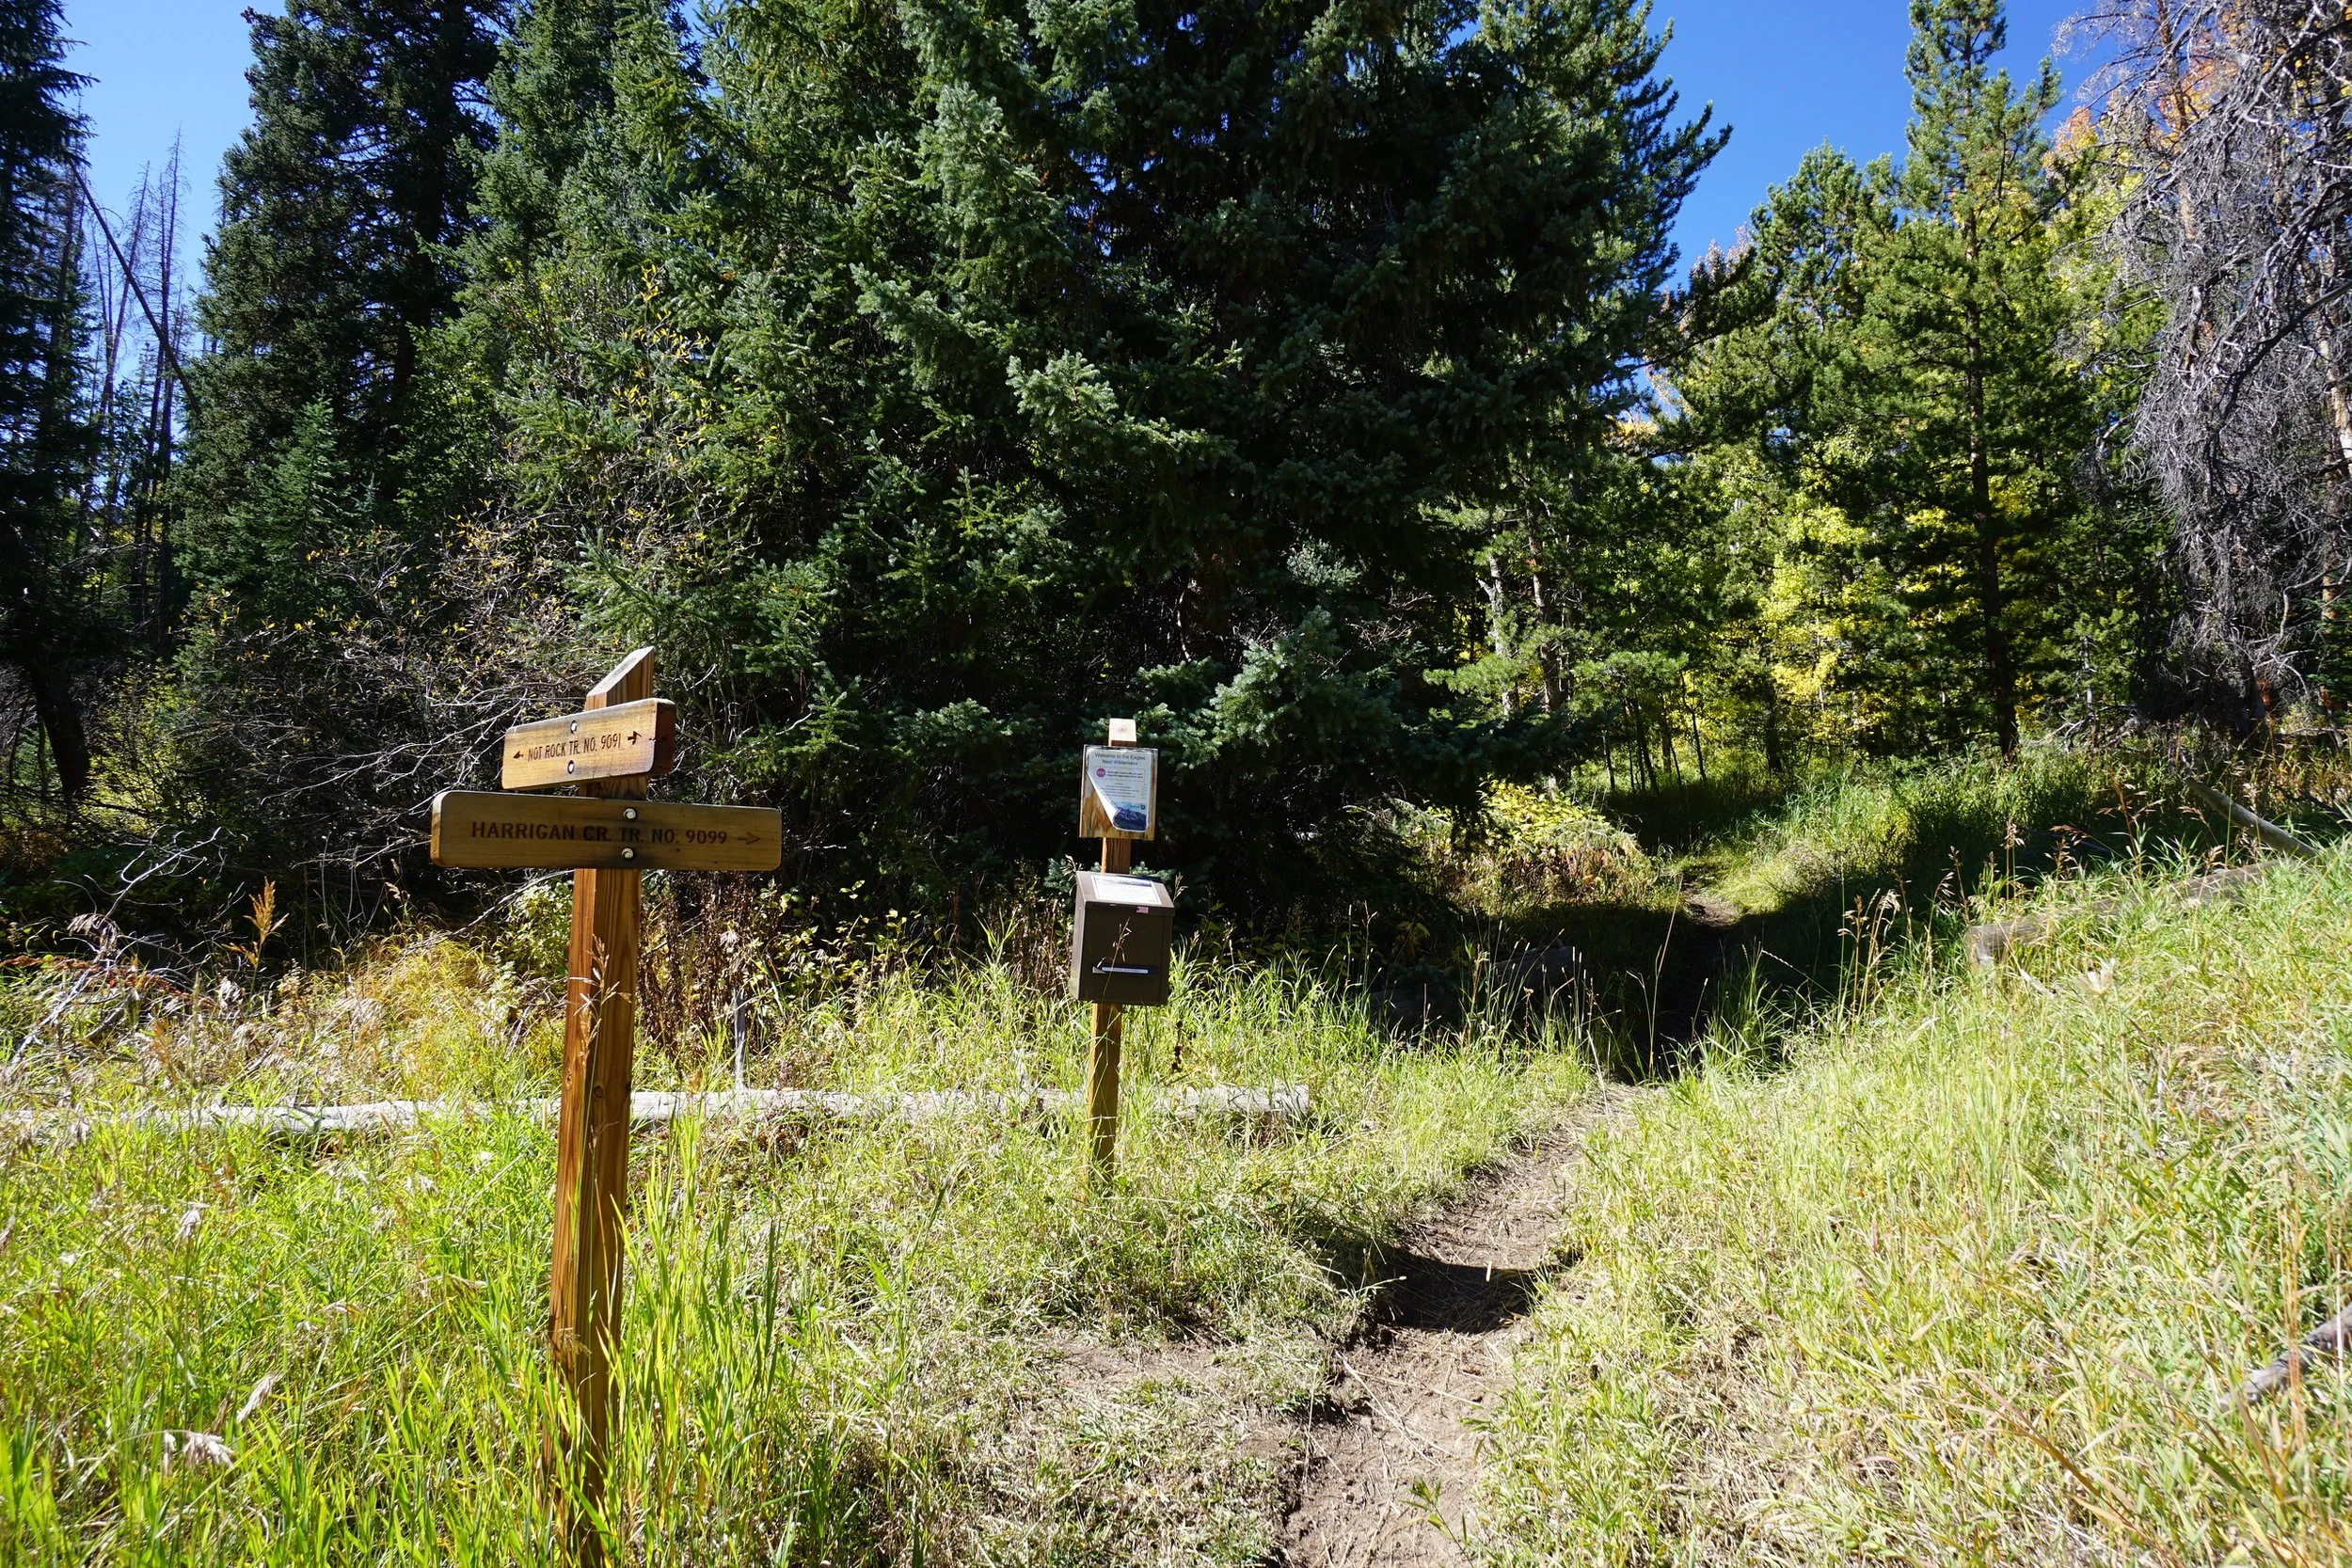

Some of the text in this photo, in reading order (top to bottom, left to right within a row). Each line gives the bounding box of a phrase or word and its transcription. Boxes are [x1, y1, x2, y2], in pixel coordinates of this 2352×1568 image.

[528, 733, 622, 762] NOT ROCK TR. NO. 9091
[471, 821, 727, 845] HARRIGAN CR. TR. NO. 9099
